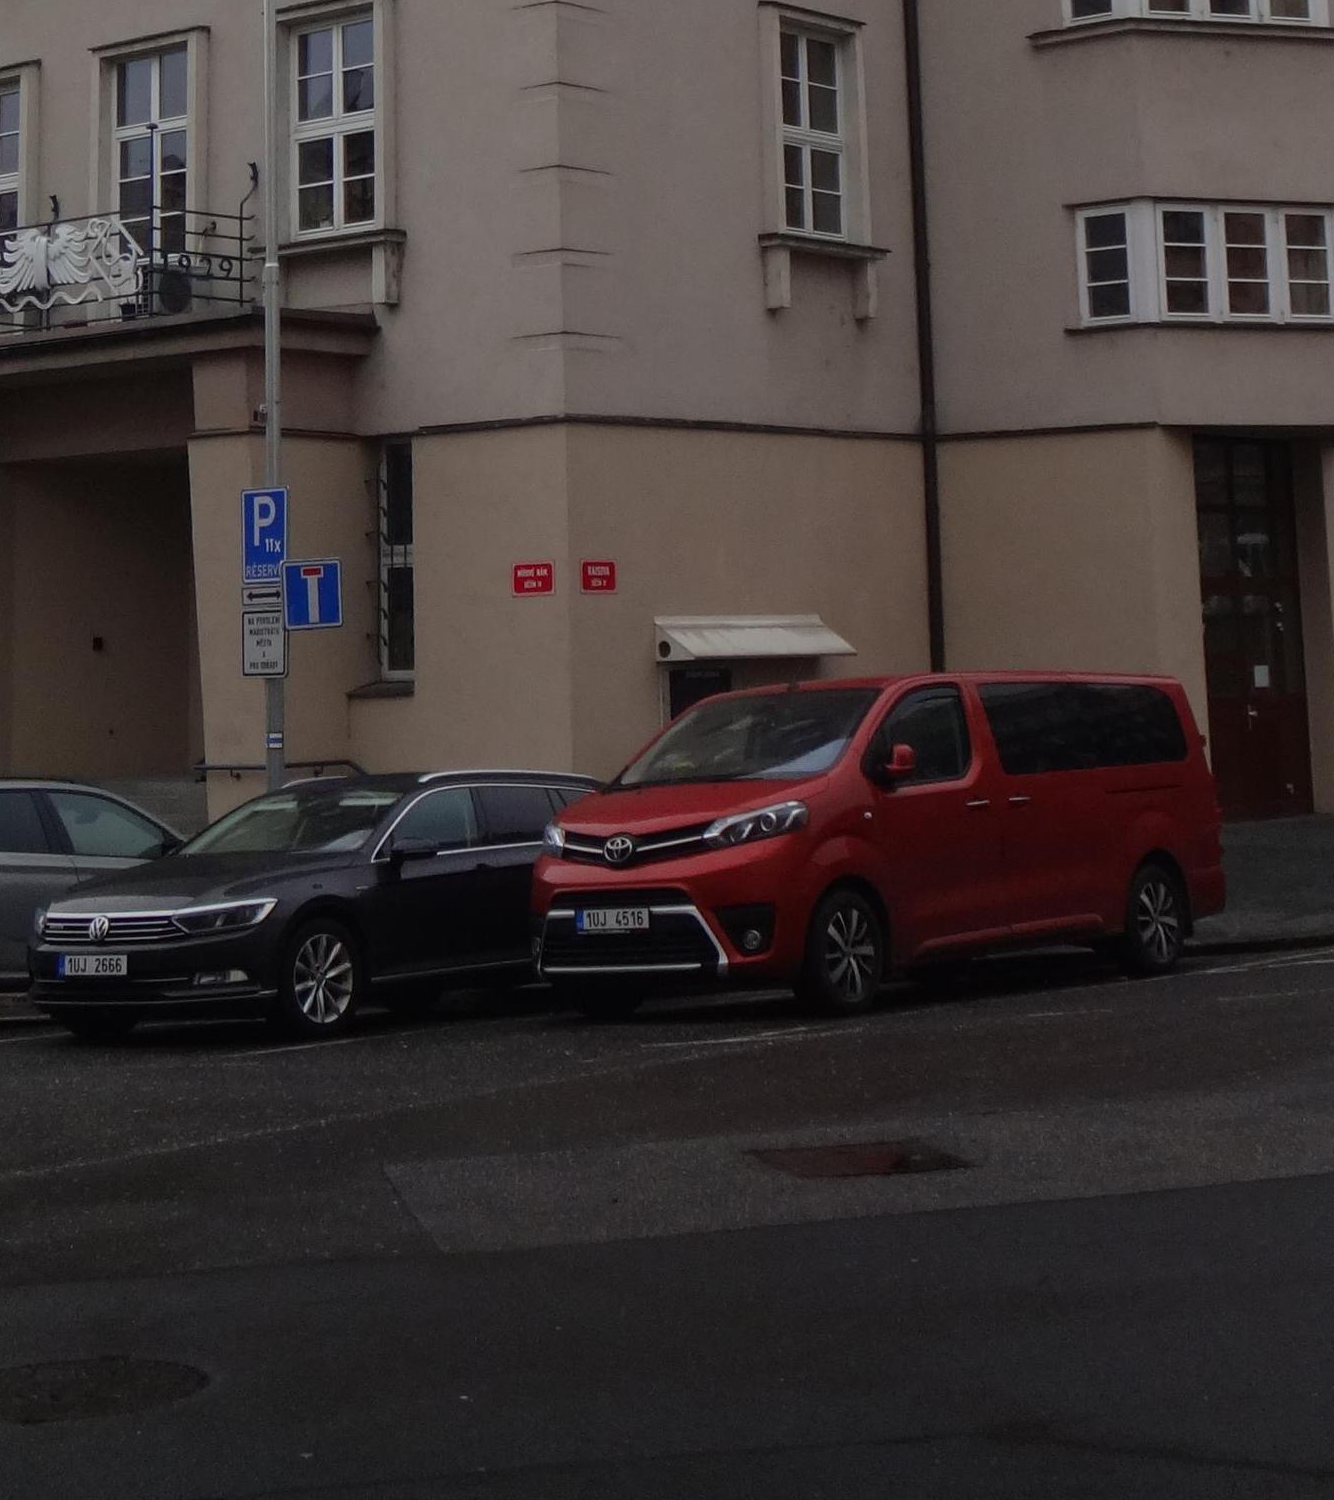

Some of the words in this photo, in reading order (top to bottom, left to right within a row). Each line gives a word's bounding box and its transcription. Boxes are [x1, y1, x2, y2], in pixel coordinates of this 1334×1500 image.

[253, 495, 276, 547] P
[245, 561, 280, 578] RÉSERV
[586, 911, 607, 928] 1UJ
[615, 910, 644, 927] 4516
[68, 957, 87, 973] 1UJ
[94, 957, 122, 973] 2666
